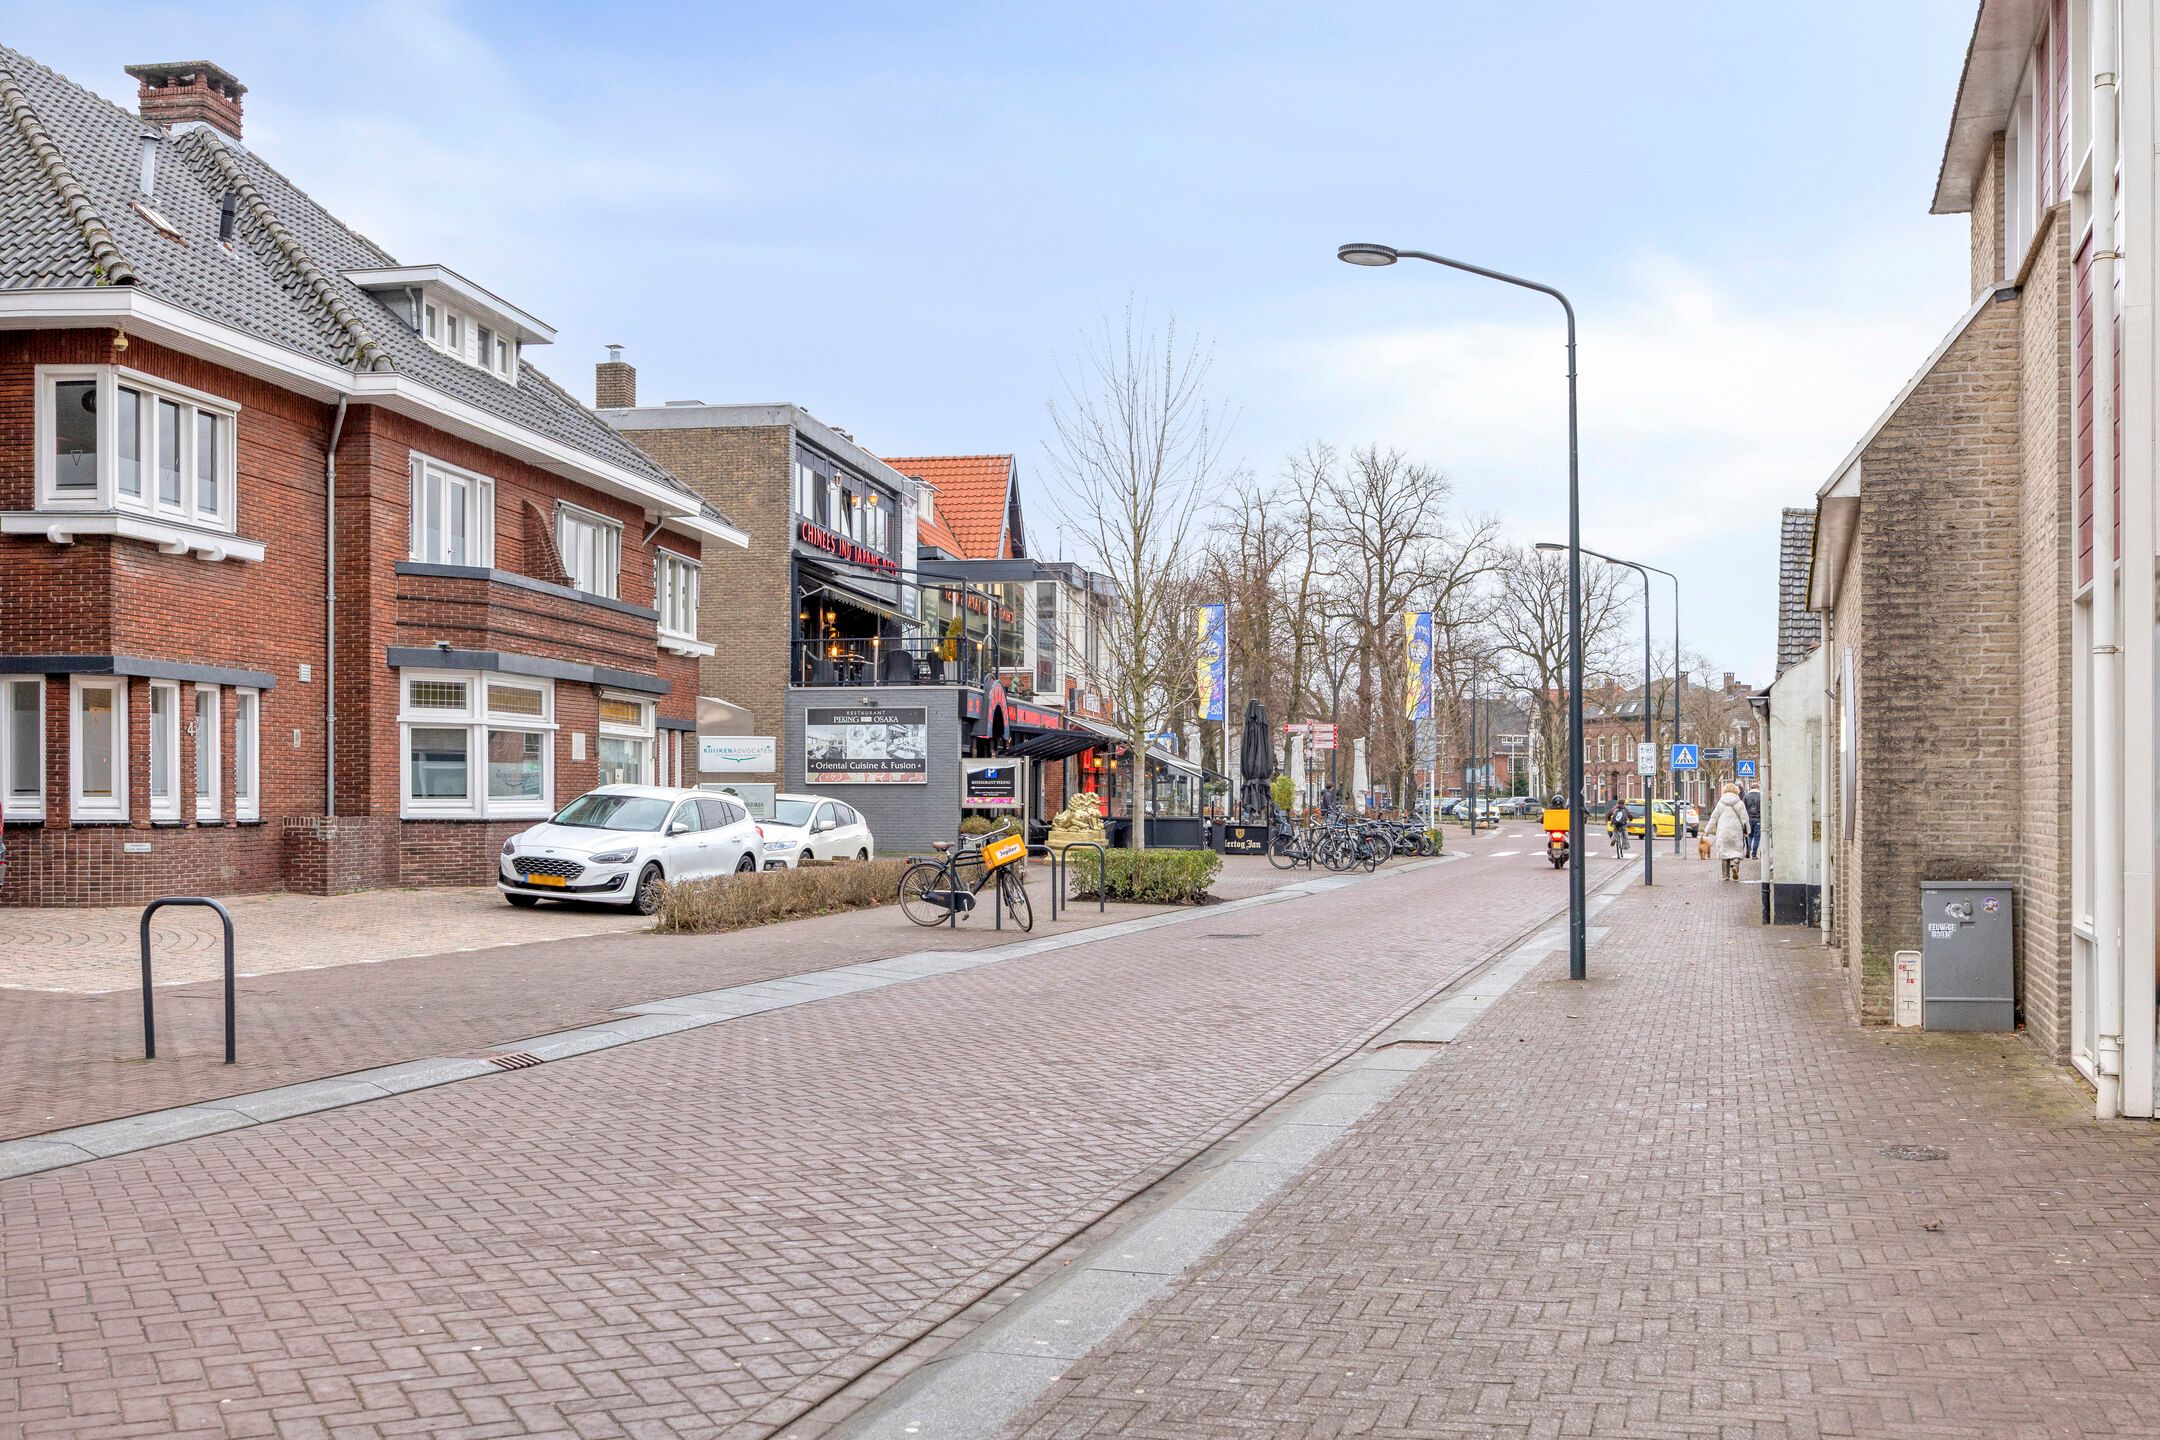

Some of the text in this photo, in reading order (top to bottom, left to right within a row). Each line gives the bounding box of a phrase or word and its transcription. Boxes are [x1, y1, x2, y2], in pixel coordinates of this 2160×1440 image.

[802, 522, 836, 553] CHINEES
[873, 715, 899, 723] OSAKA
[187, 721, 194, 737] 4
[815, 761, 916, 770] Oriental Cuisine & Fusion
